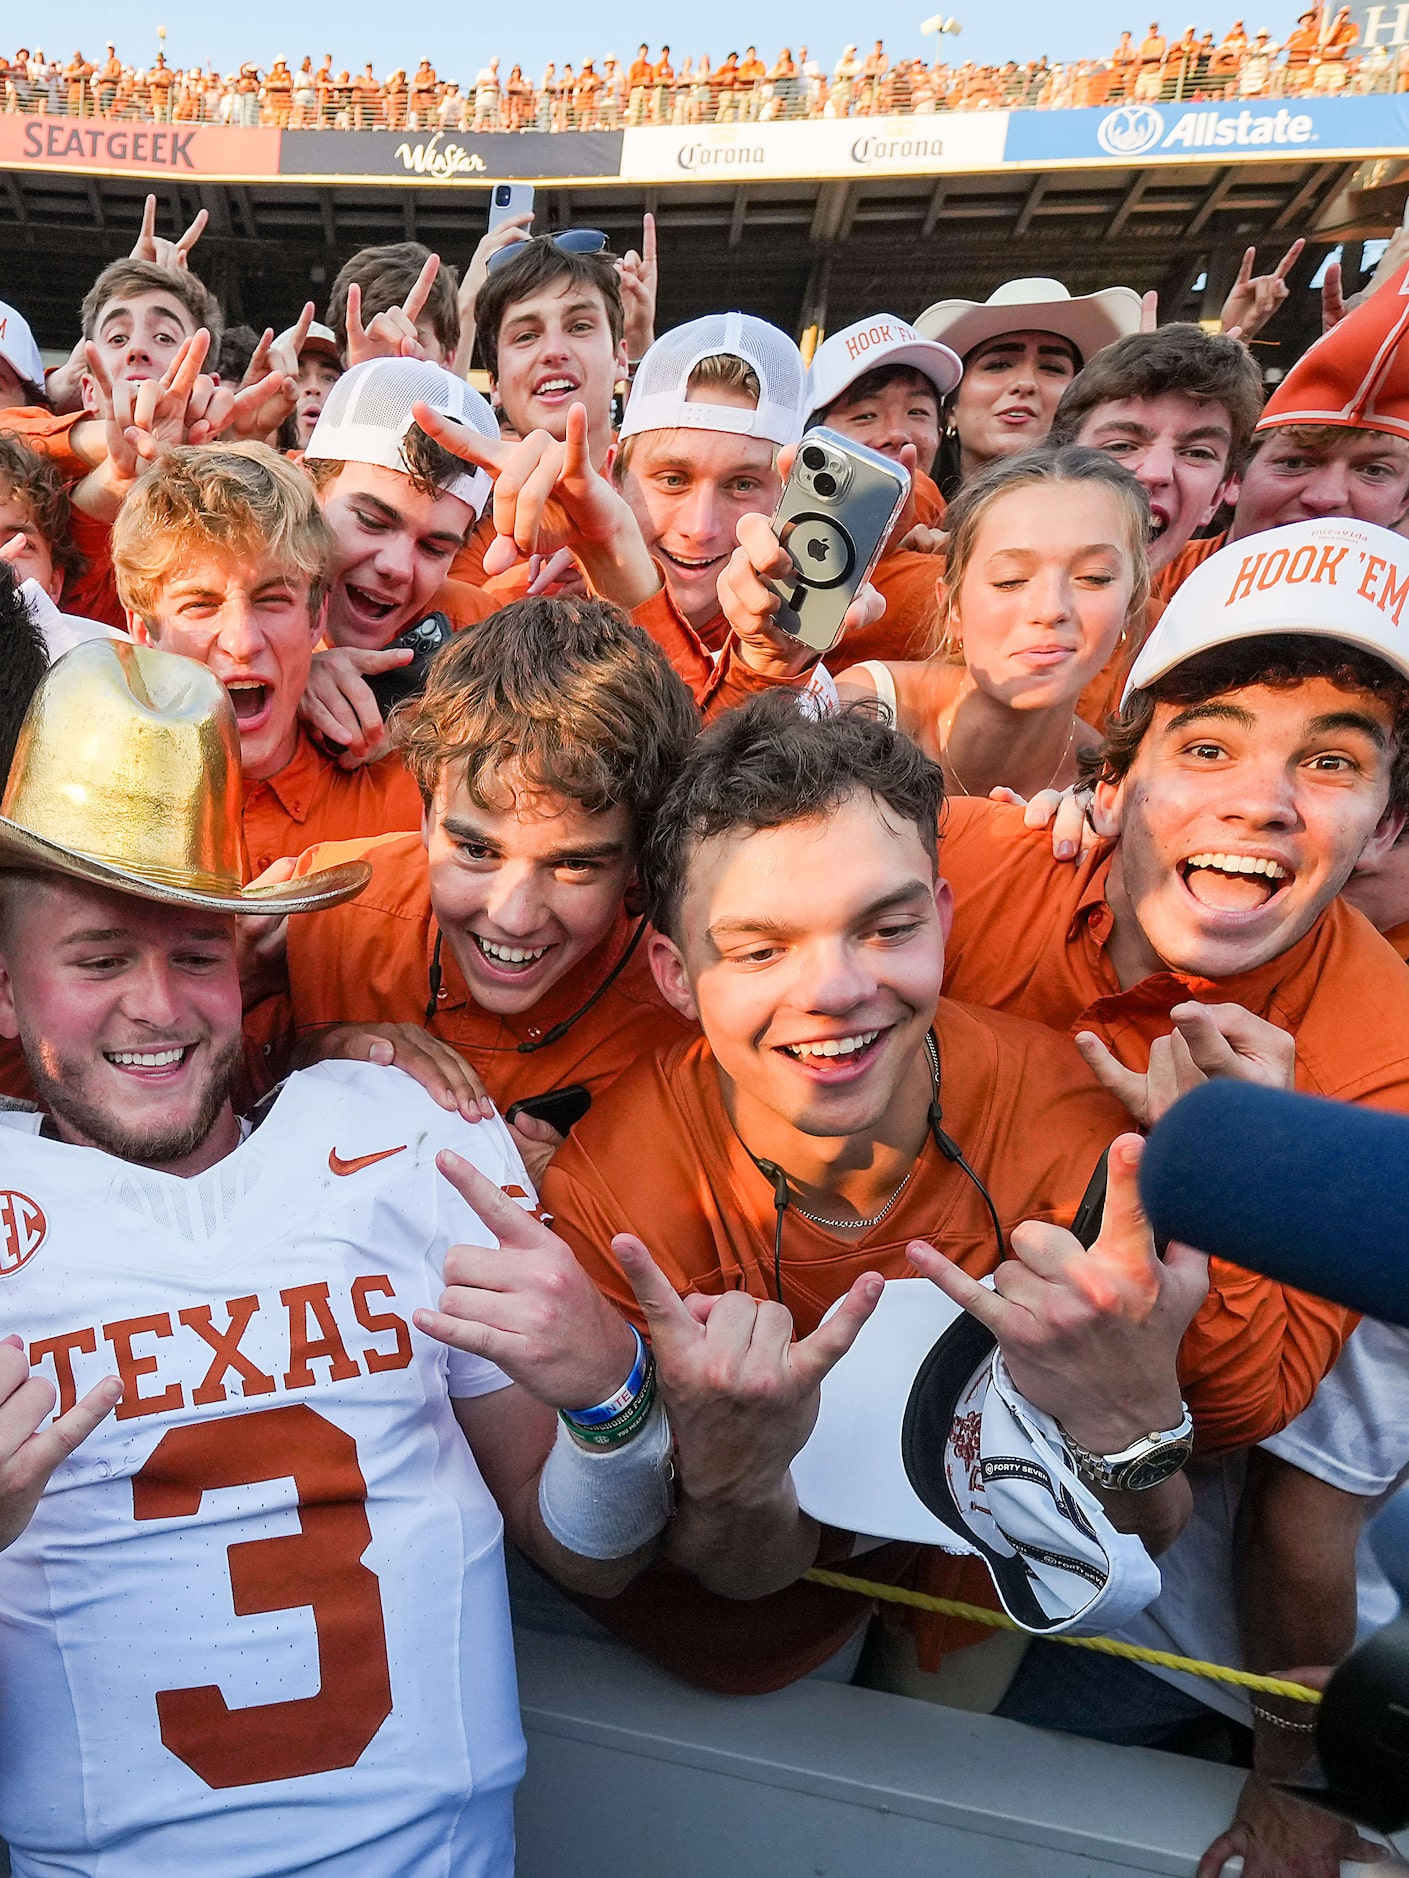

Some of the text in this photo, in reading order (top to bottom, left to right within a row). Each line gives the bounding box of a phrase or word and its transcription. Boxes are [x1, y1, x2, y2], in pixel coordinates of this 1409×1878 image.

[23, 121, 197, 168] SEATGEEK
[1160, 108, 1314, 148] Allstate
[393, 131, 487, 178] WinStar
[677, 143, 765, 172] Corona
[850, 135, 944, 167] Corona
[845, 325, 894, 361] HOOK
[1224, 545, 1409, 628] HOOK 'EM
[29, 1274, 414, 1423] TEXAS
[1021, 1466, 1048, 1480] SEVEN
[1058, 1561, 1084, 1573] FORTY
[131, 1403, 393, 1790] 3
